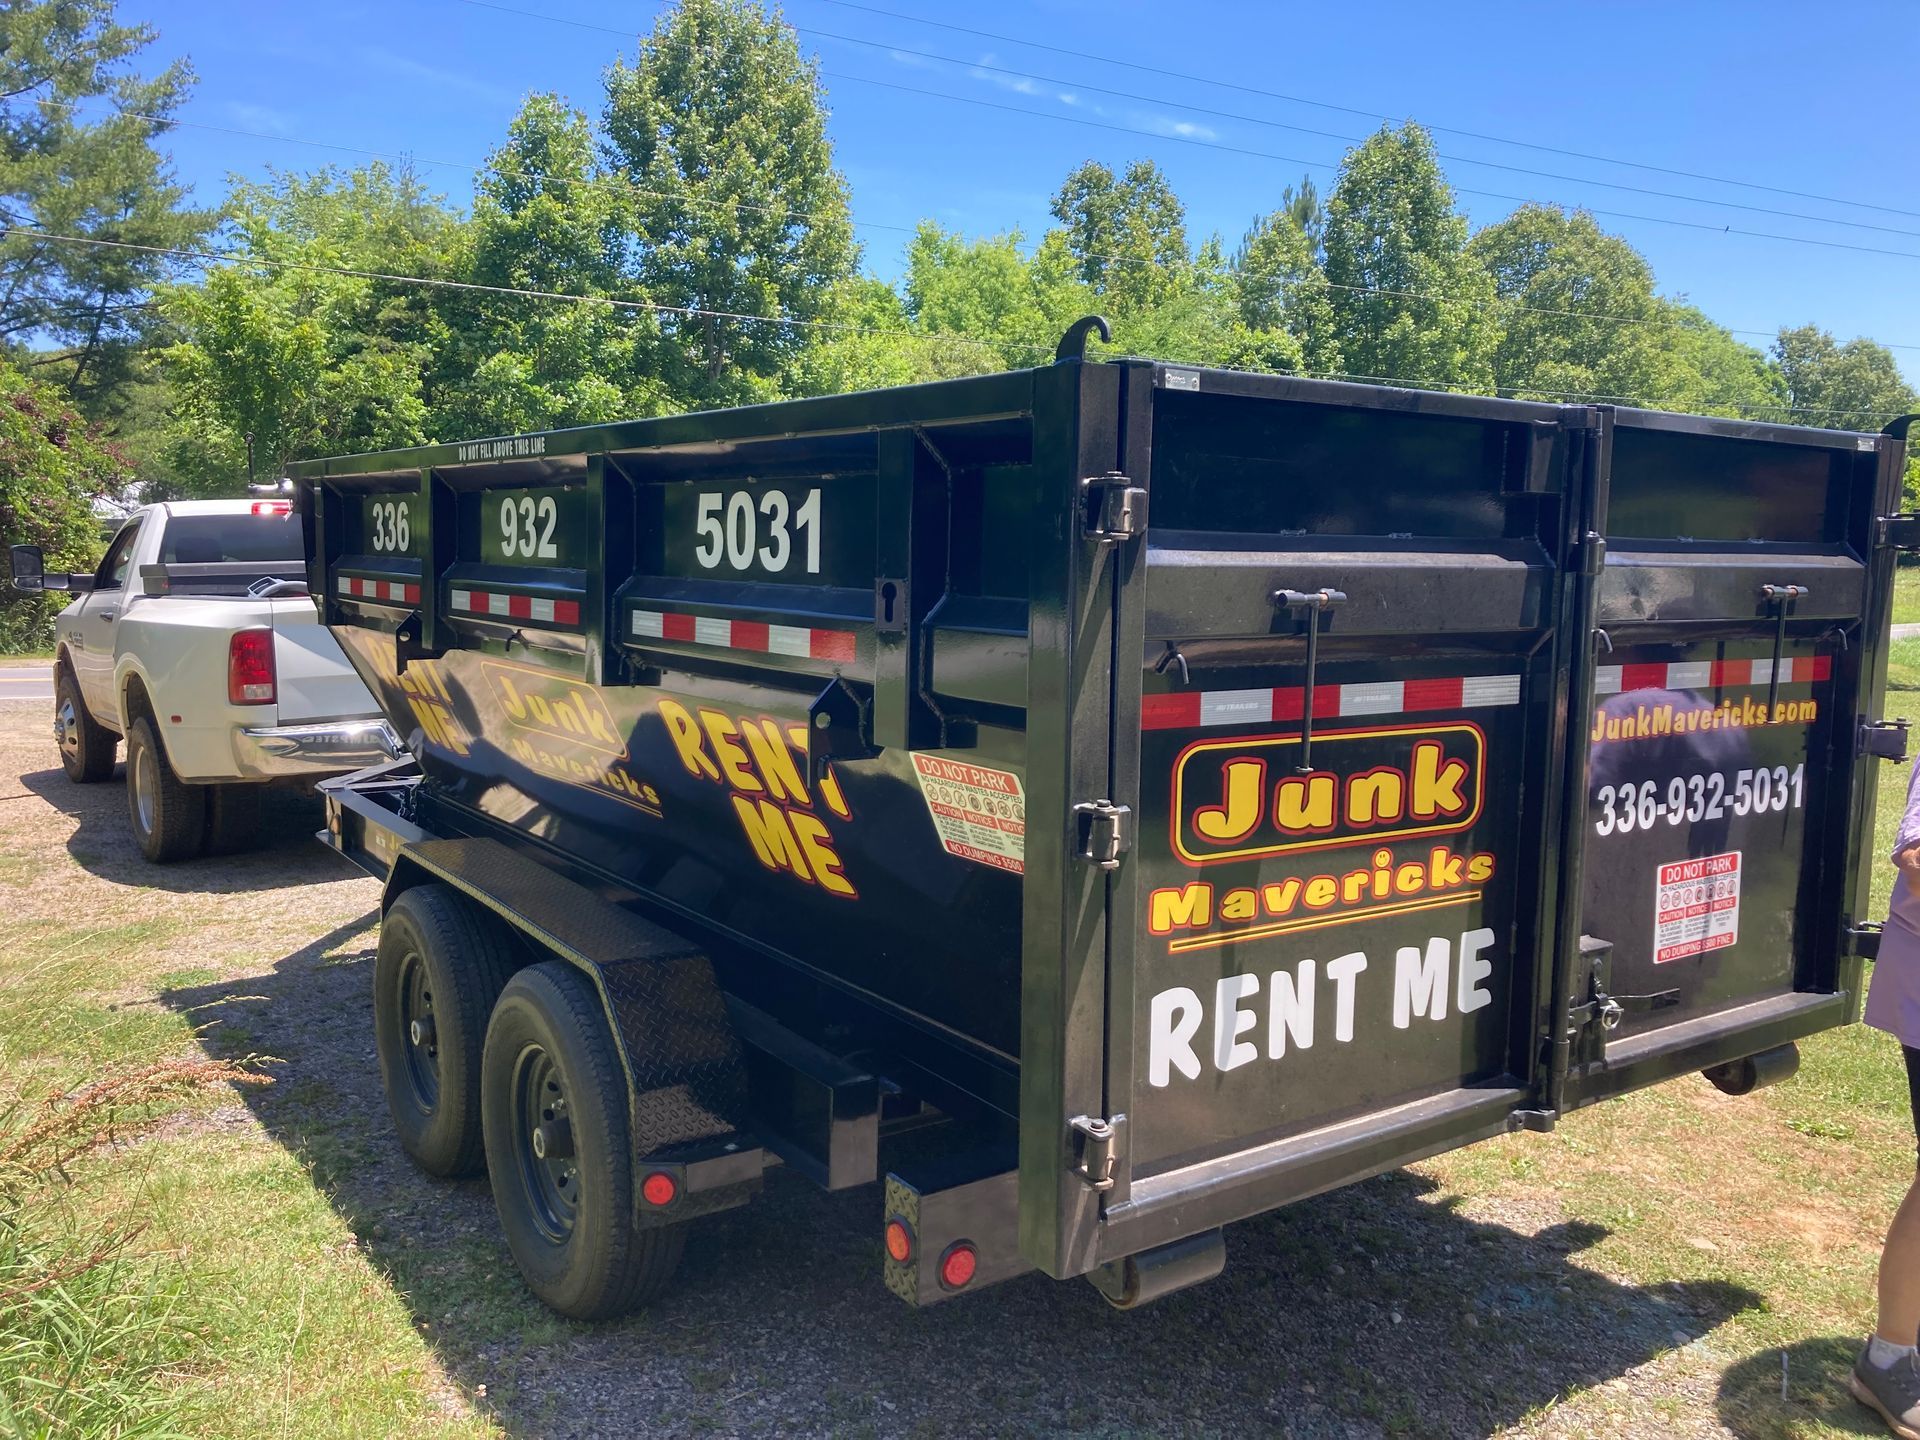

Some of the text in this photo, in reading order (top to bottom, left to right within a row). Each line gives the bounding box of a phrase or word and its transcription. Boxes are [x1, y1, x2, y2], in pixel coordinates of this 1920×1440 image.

[459, 437, 545, 460] DO NOT FILL ABOVE THIS LINE
[372, 501, 410, 552] 336
[501, 496, 558, 559] 932
[695, 488, 822, 574] 5031
[406, 696, 470, 757] ME
[499, 675, 616, 744] Junk
[1591, 696, 1818, 742] JunkMaverickscom
[511, 738, 662, 805] Mavericks
[921, 774, 1023, 804] NO HAZARDOUS WASTES ACCEPTED
[922, 758, 1010, 792] DO NOT PARK
[1195, 742, 1467, 843] Junk
[932, 803, 1024, 834] CAUTION NOTICE NOTIC
[1596, 763, 1804, 836] 336-932-5031
[730, 793, 858, 897] ME
[950, 842, 1023, 872] NO DUMPING $500
[1666, 856, 1733, 883] DO NOT PARK
[1149, 846, 1495, 934] Mavericks
[1660, 899, 1734, 922] CAUTION NOTICE NOTICE
[1668, 881, 1696, 892] HAZARDOUS
[1660, 948, 1671, 960] NO
[1671, 942, 1702, 957] DUMPING
[1717, 934, 1732, 946] FINE
[1149, 928, 1495, 1087] RENT ME
